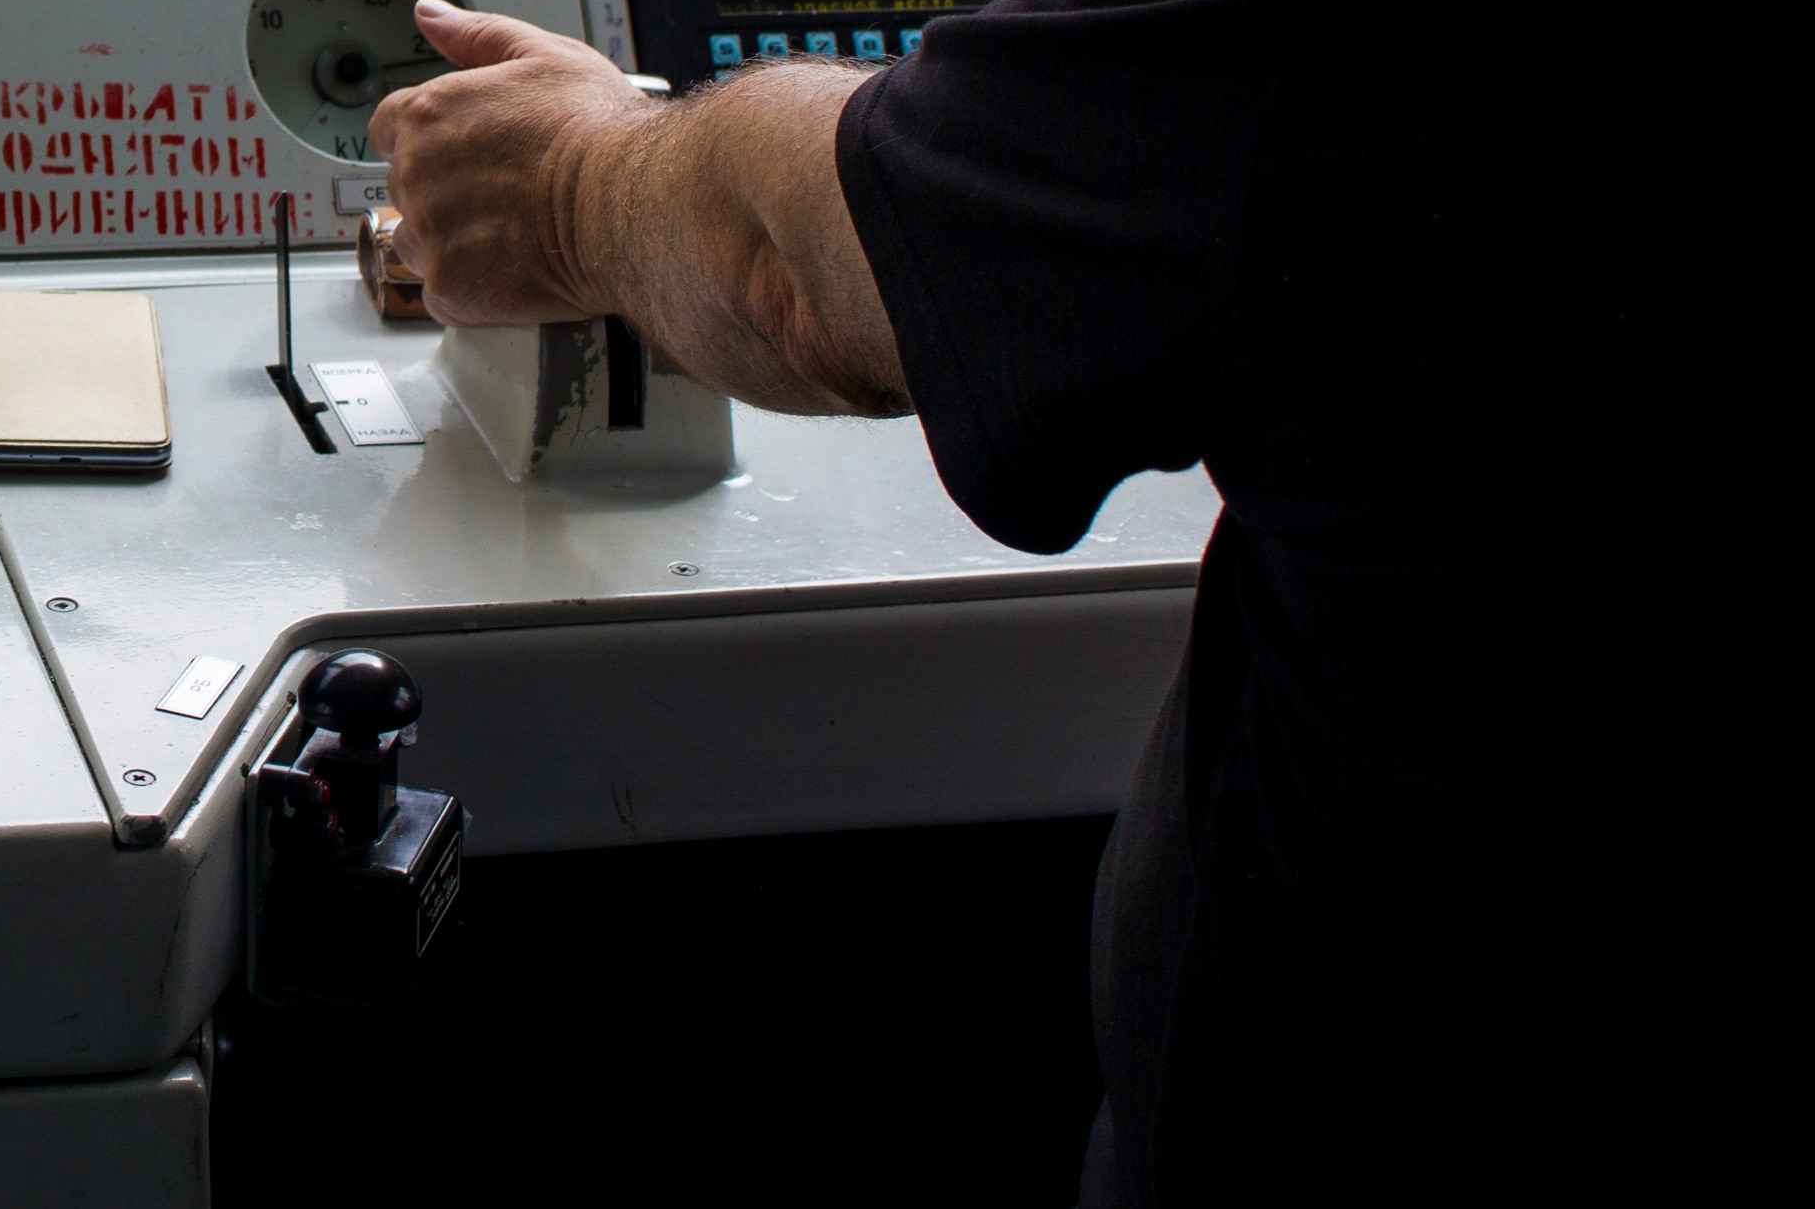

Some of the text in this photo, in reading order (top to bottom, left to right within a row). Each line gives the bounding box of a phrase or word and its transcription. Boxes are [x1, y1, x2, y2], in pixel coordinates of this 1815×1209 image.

[260, 9, 284, 30] 10
[321, 368, 377, 376] ВПЕРЕД
[356, 428, 412, 436] НАЗАД
